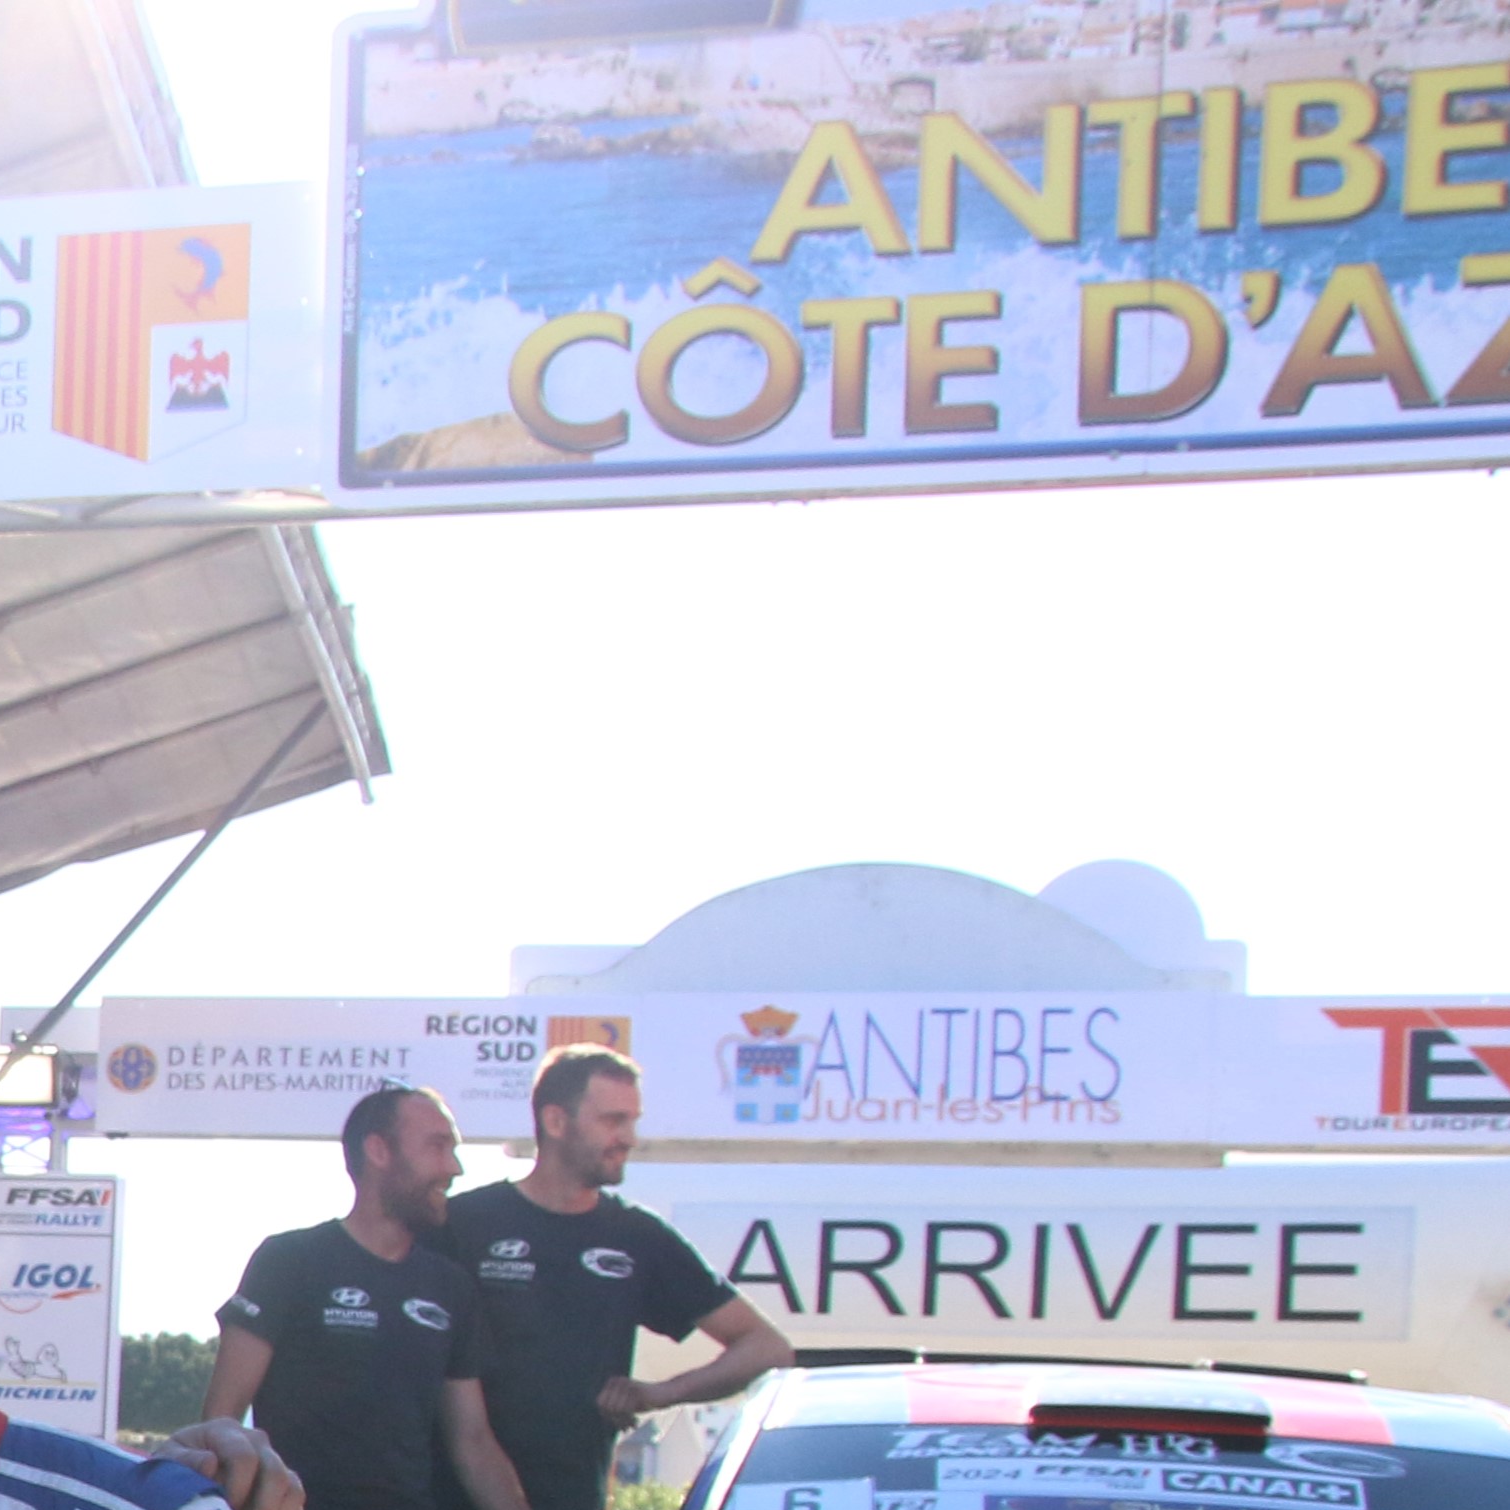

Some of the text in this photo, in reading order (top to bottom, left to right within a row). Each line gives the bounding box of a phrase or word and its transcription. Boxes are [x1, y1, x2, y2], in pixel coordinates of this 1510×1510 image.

[508, 257, 1001, 453] CÔTE
[426, 1011, 537, 1036] RÉGION
[167, 1041, 411, 1069] DÉPARTEMENT
[478, 1041, 536, 1062] SUD
[803, 1006, 1122, 1103] ANTIBES
[167, 1071, 207, 1091] DES
[803, 1082, 1122, 1124] Juan-les-Pins
[35, 1213, 103, 1226] RALLYE
[727, 1217, 1365, 1323] ARRIVEE
[942, 1467, 1023, 1480] 2024
[1167, 1471, 1353, 1503] CANAL+
